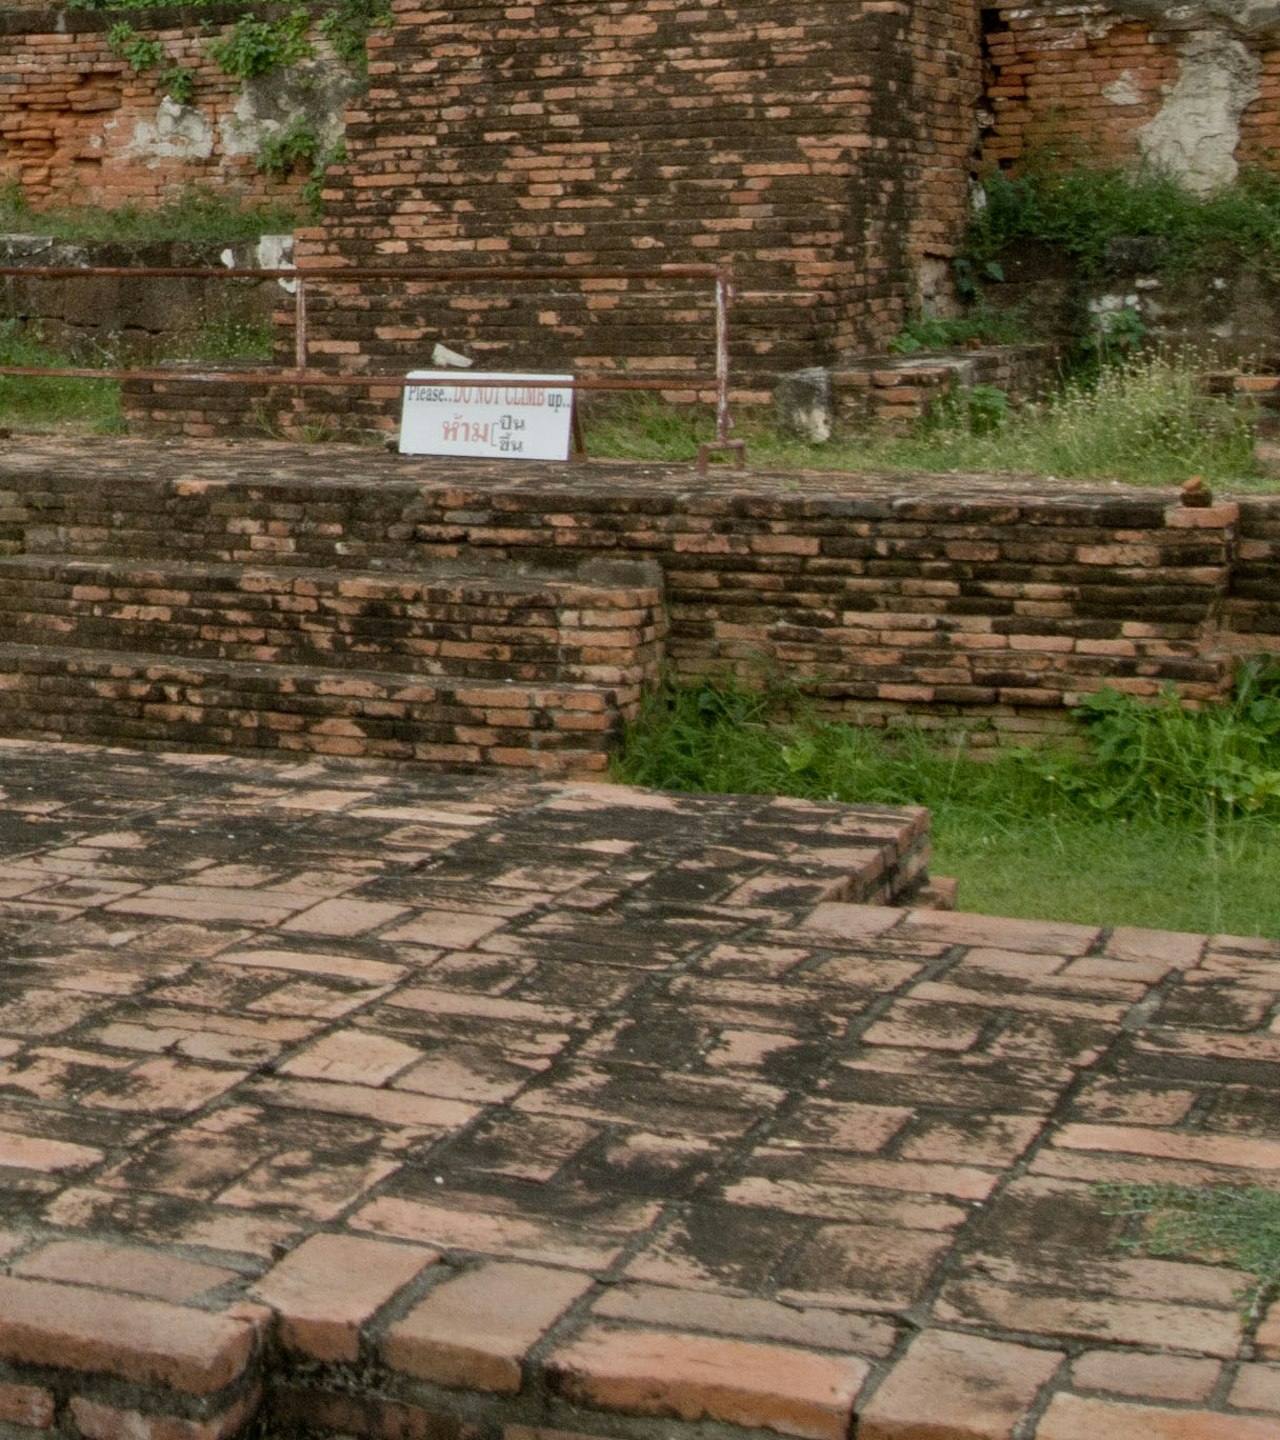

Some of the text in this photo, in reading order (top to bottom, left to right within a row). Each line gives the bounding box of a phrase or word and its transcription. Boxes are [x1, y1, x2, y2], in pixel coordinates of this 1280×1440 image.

[474, 386, 499, 405] NOT
[505, 387, 545, 407] CLIMB
[442, 412, 490, 443] ห้าม
